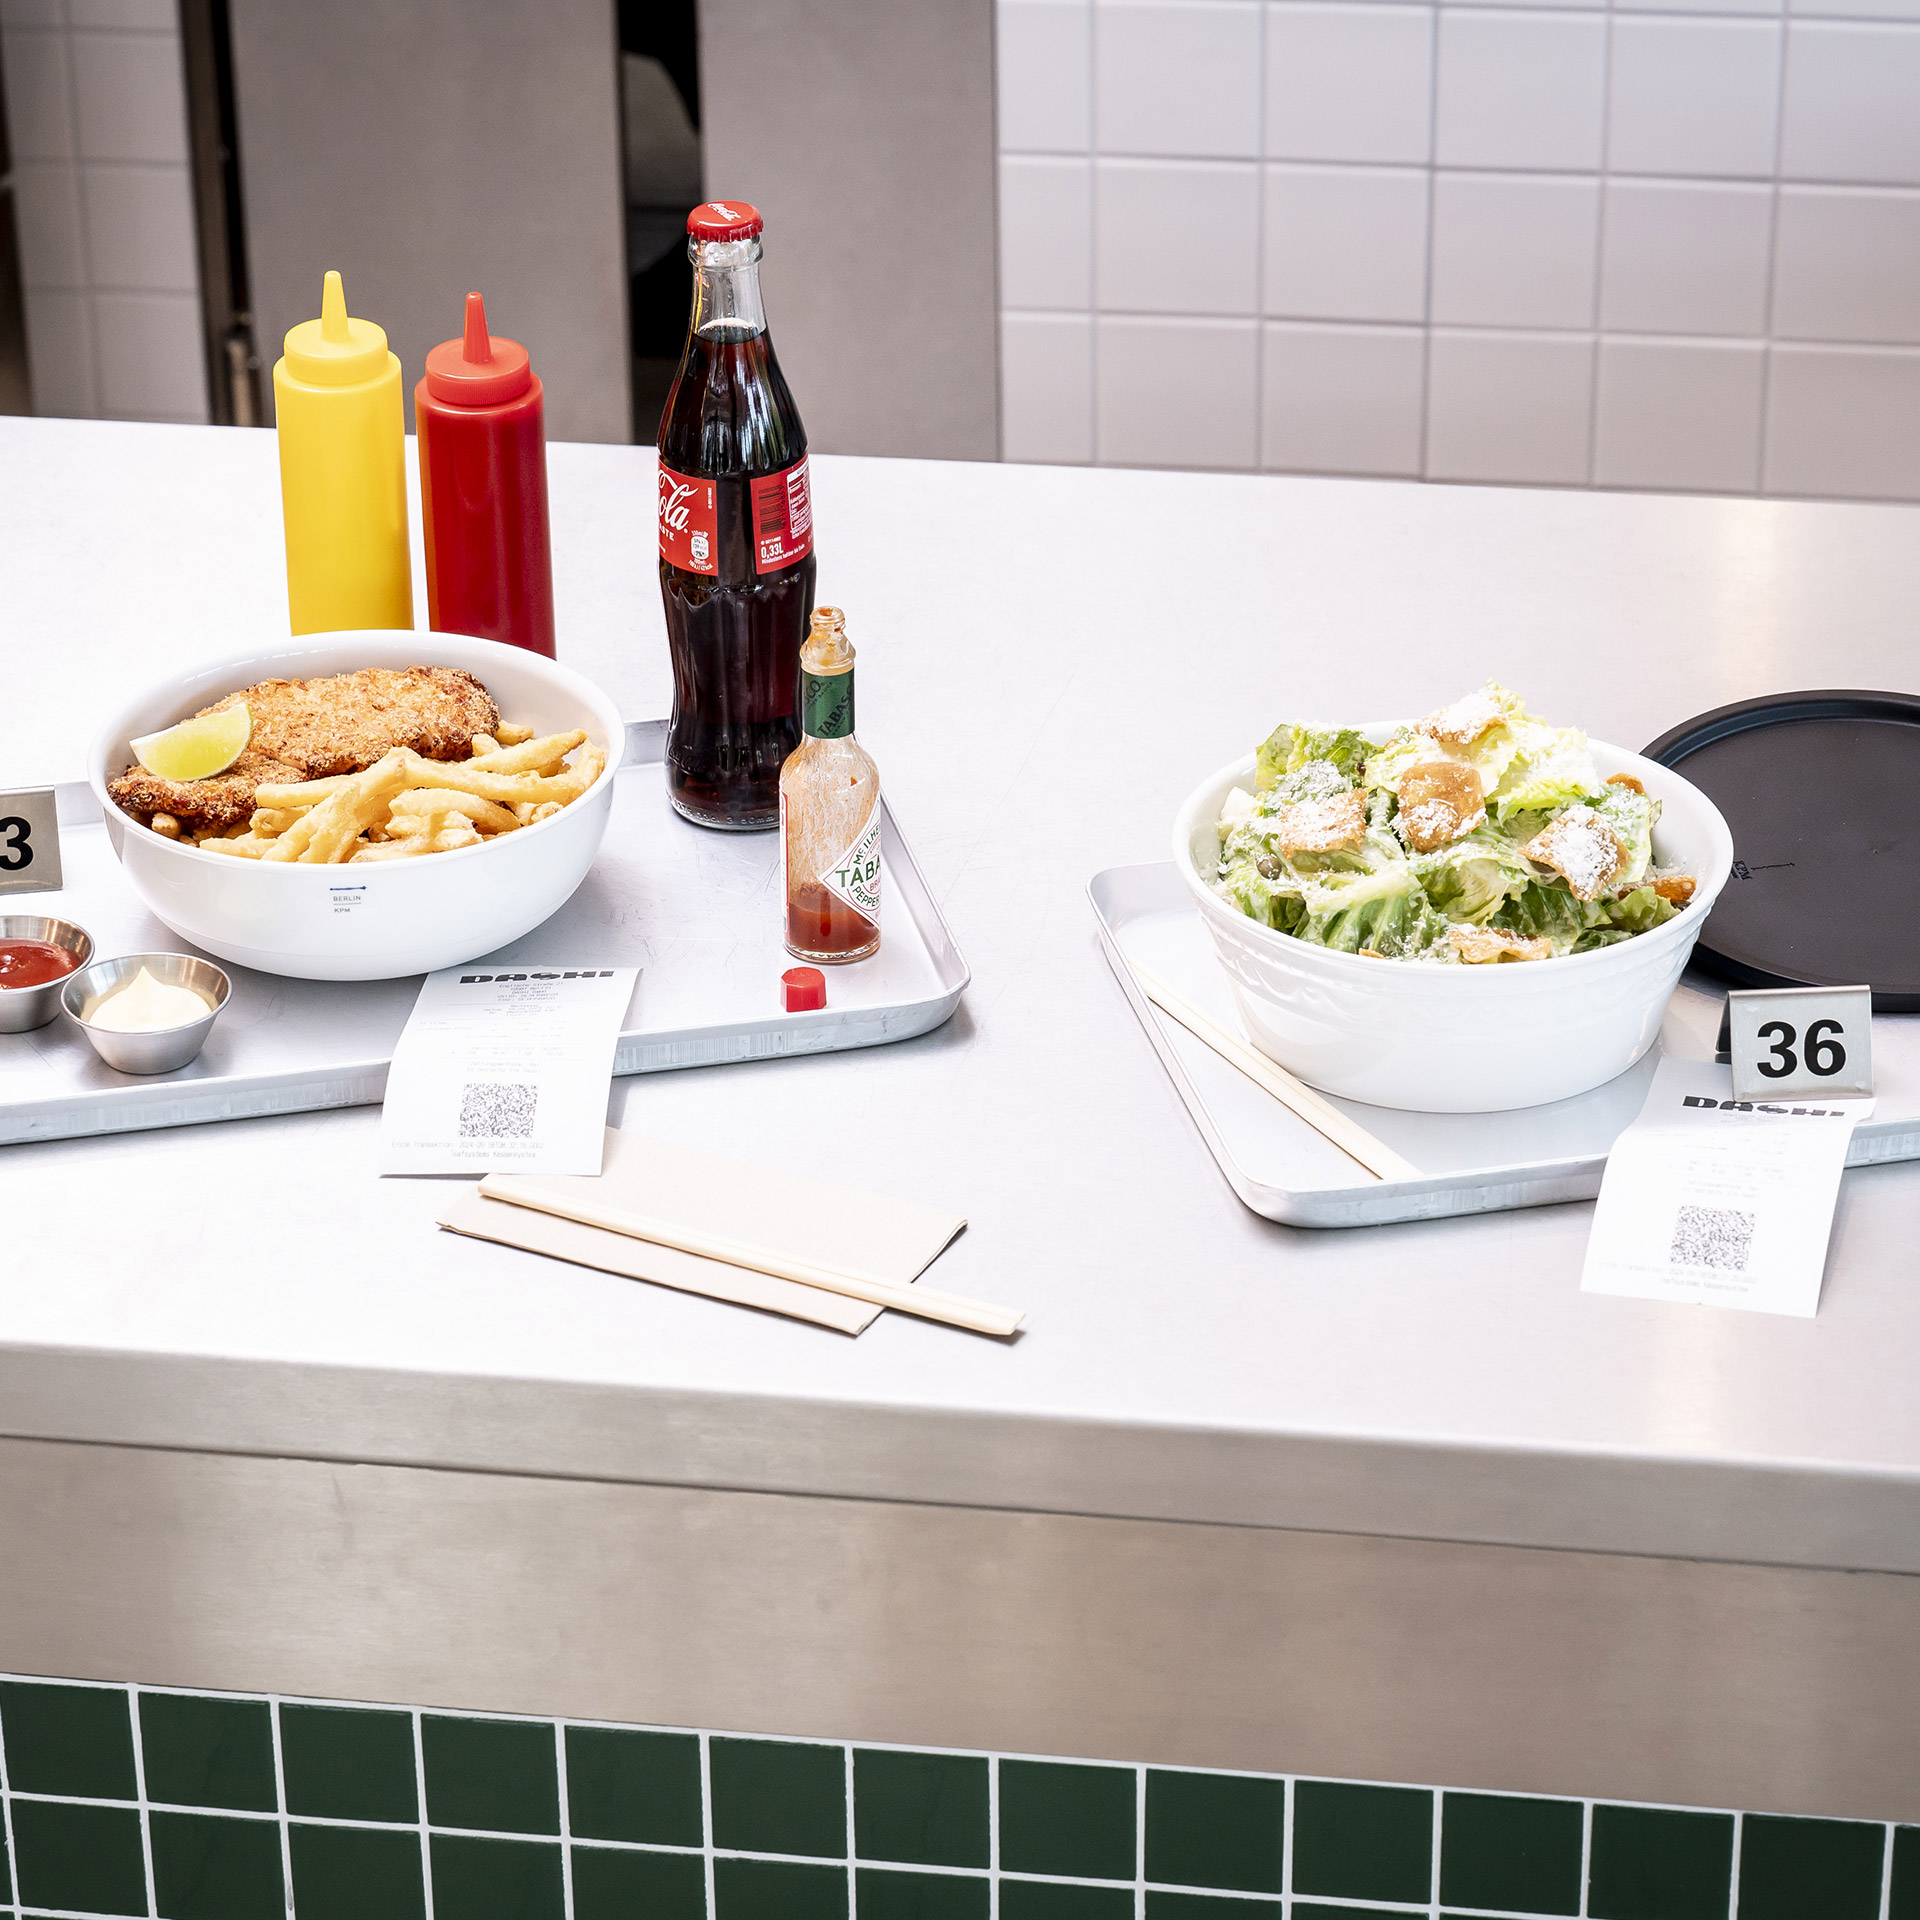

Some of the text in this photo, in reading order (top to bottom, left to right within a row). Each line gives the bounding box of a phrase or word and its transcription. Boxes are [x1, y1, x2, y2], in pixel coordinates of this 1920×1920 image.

[760, 542, 784, 559] 0,33L
[0, 816, 34, 870] 3
[460, 970, 615, 984] DASHI
[1756, 1018, 1847, 1078] 36
[1682, 1095, 1845, 1117] DASHI
